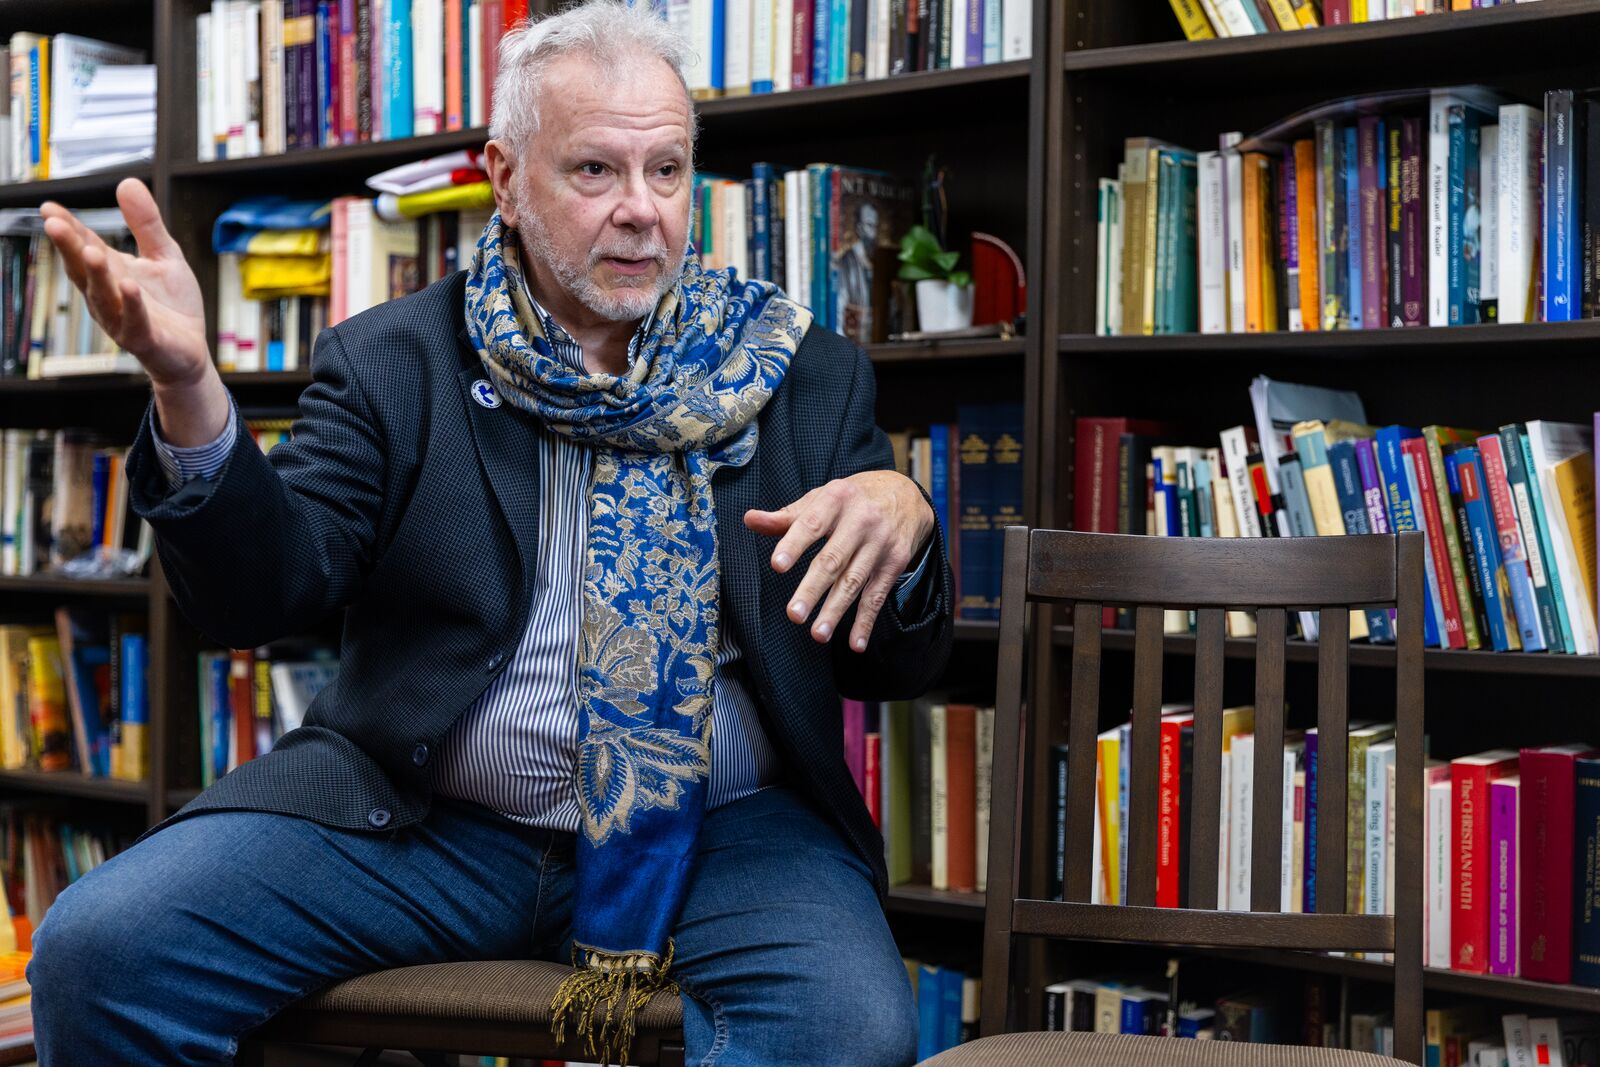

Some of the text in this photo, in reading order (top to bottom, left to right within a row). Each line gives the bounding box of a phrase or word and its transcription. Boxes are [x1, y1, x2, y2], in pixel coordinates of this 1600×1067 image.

[1434, 224, 1444, 257] Reader
[1161, 744, 1173, 784] Catholic
[1161, 786, 1173, 814] Adult
[1369, 799, 1381, 830] Being
[1371, 833, 1382, 847] As
[1460, 777, 1474, 910] The CHRISTIAN FAITH
